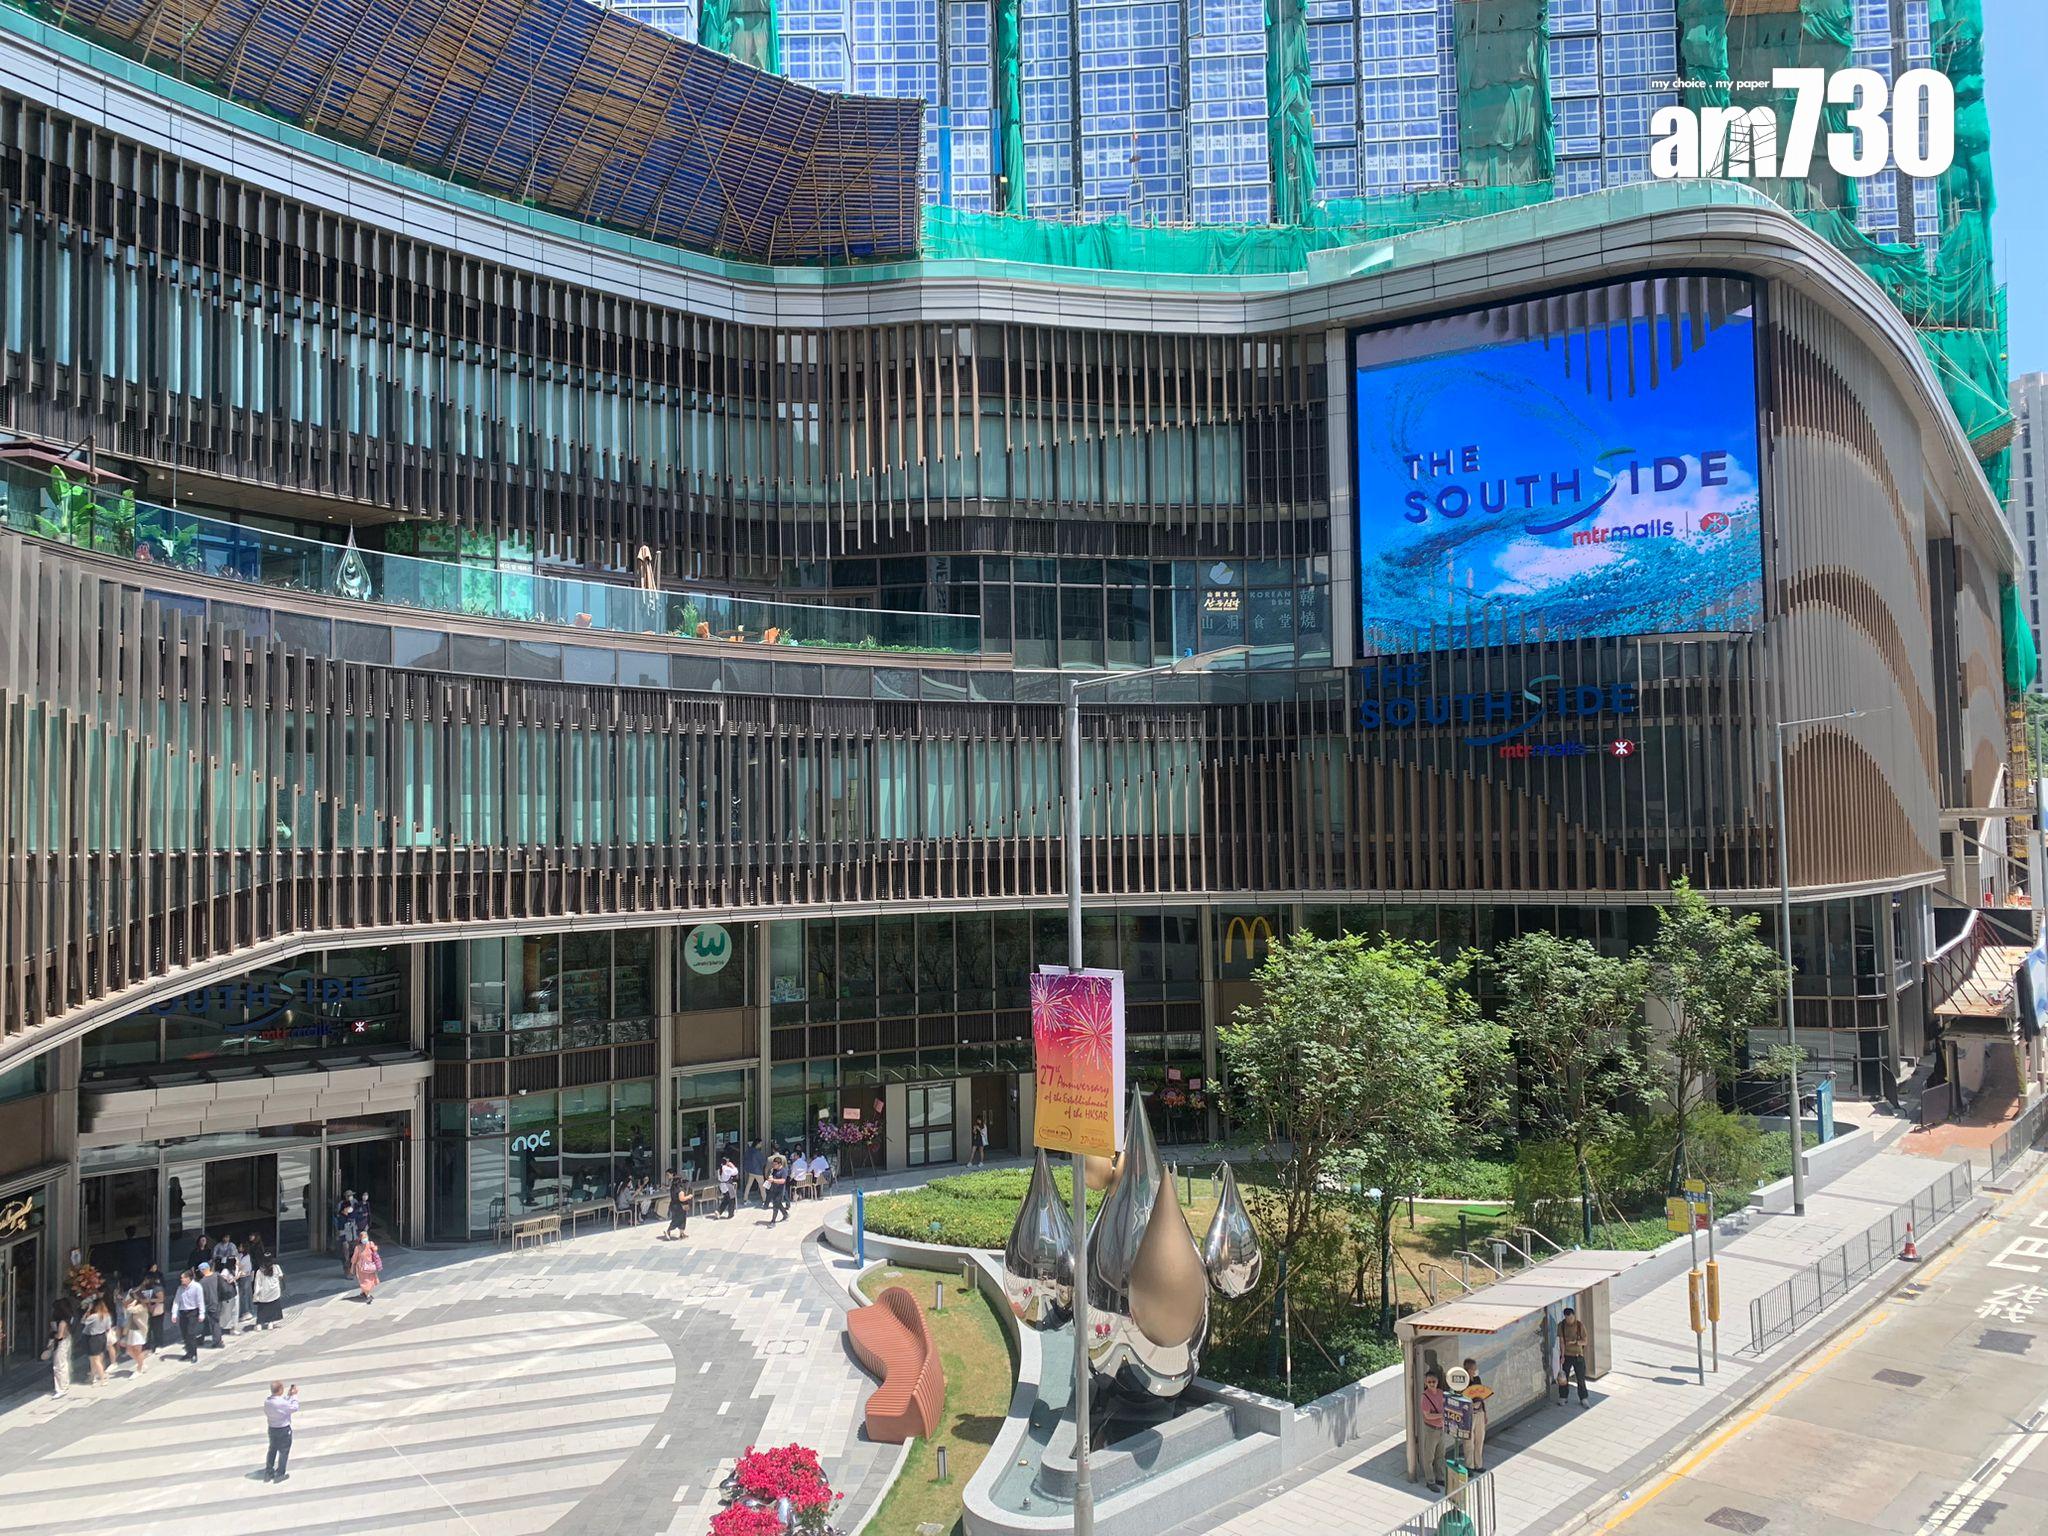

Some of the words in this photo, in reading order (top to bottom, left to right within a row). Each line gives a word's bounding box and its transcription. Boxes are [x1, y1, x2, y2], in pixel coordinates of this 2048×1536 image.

[1403, 444, 1480, 481] THE
[1573, 519, 1674, 547] mtrmalls
[1359, 663, 1424, 690] THE
[1057, 1074, 1109, 1098] Anniversary
[1044, 1091, 1052, 1104] of
[1063, 1093, 1108, 1108] Establishment
[1064, 1106, 1071, 1119] of
[1073, 1108, 1082, 1118] the
[1085, 1109, 1108, 1122] HKSAR
